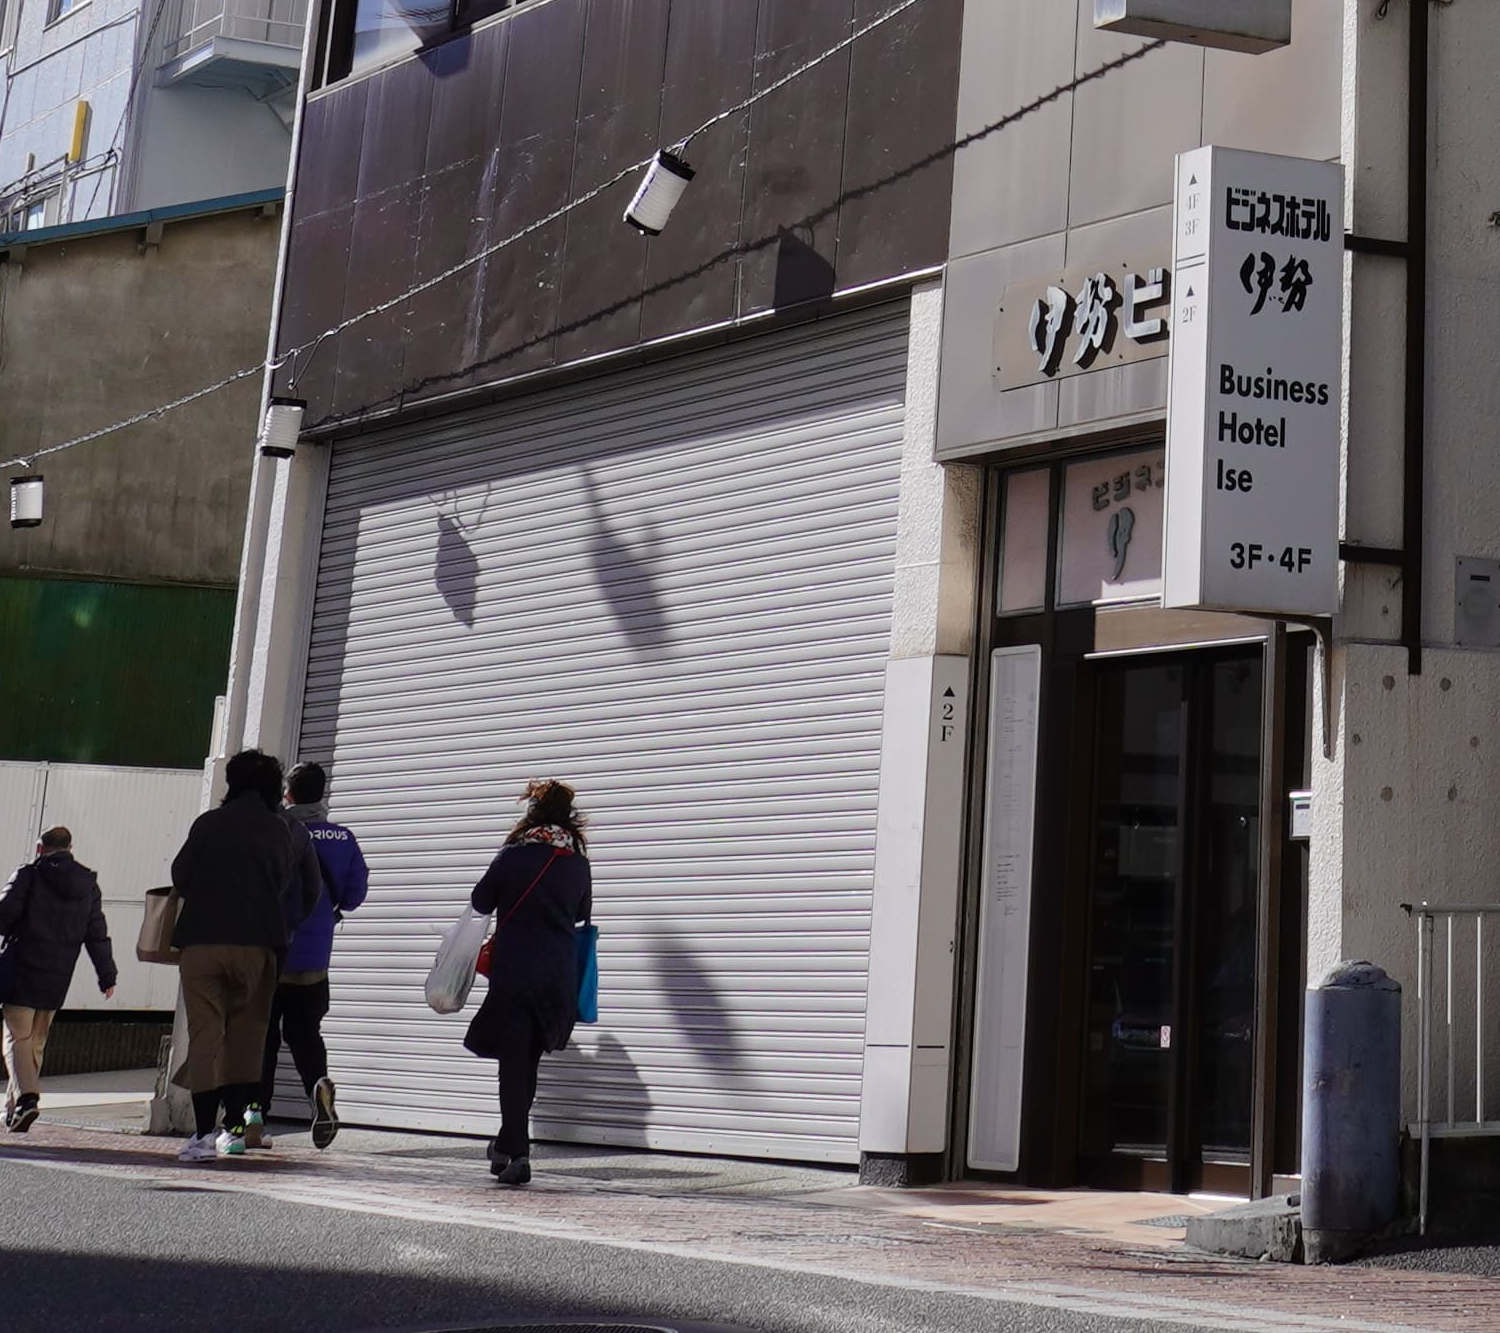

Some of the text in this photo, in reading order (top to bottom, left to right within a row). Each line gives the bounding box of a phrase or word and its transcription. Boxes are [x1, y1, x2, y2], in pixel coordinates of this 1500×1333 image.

[1226, 186, 1331, 242] ビジネスホテル
[1219, 364, 1329, 406] Business
[1218, 411, 1286, 448] Hotel
[1216, 458, 1253, 493] Ise
